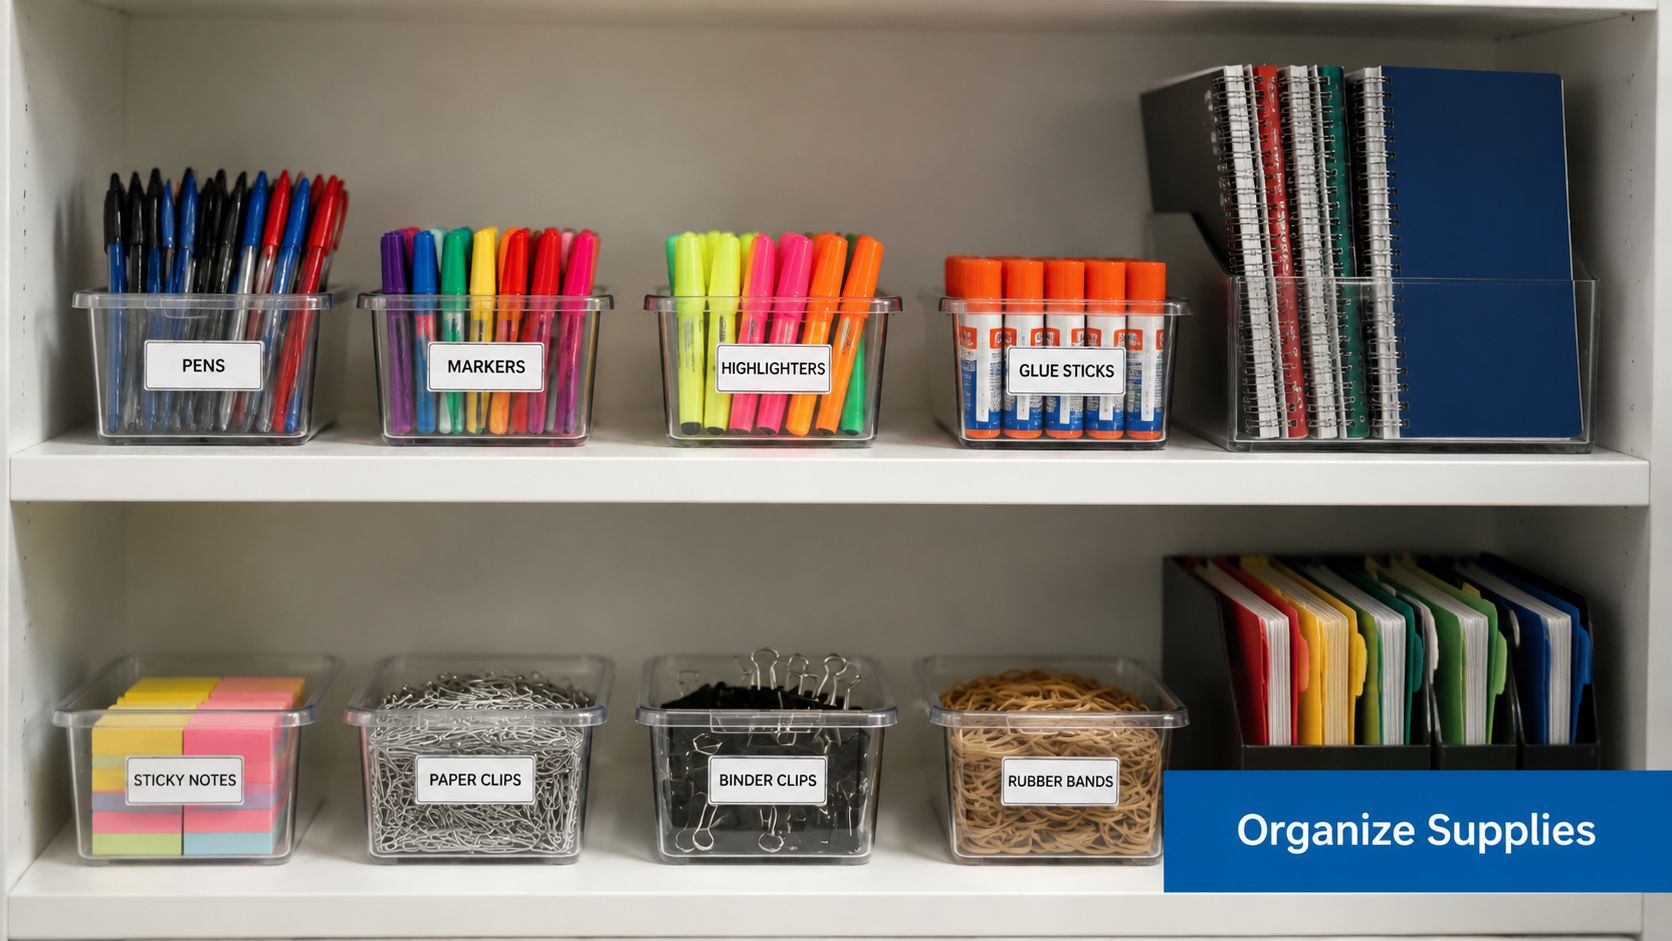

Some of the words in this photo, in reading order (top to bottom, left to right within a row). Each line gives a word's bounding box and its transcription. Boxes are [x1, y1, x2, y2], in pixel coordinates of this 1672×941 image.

[183, 359, 225, 372] PENS
[448, 360, 526, 373] MARKERS
[721, 362, 826, 376] HIGHLIGHTERS
[1019, 364, 1059, 377] GLUE
[1063, 364, 1115, 378] STICKS
[134, 774, 184, 787] STICKY
[189, 774, 237, 787] NOTES
[429, 774, 476, 787] PAPER
[480, 774, 522, 787] CLIPS
[719, 774, 773, 787] BINDER
[777, 774, 817, 787] CLIPS
[1008, 775, 1063, 788] RUBBER
[1066, 775, 1114, 788] BANDS
